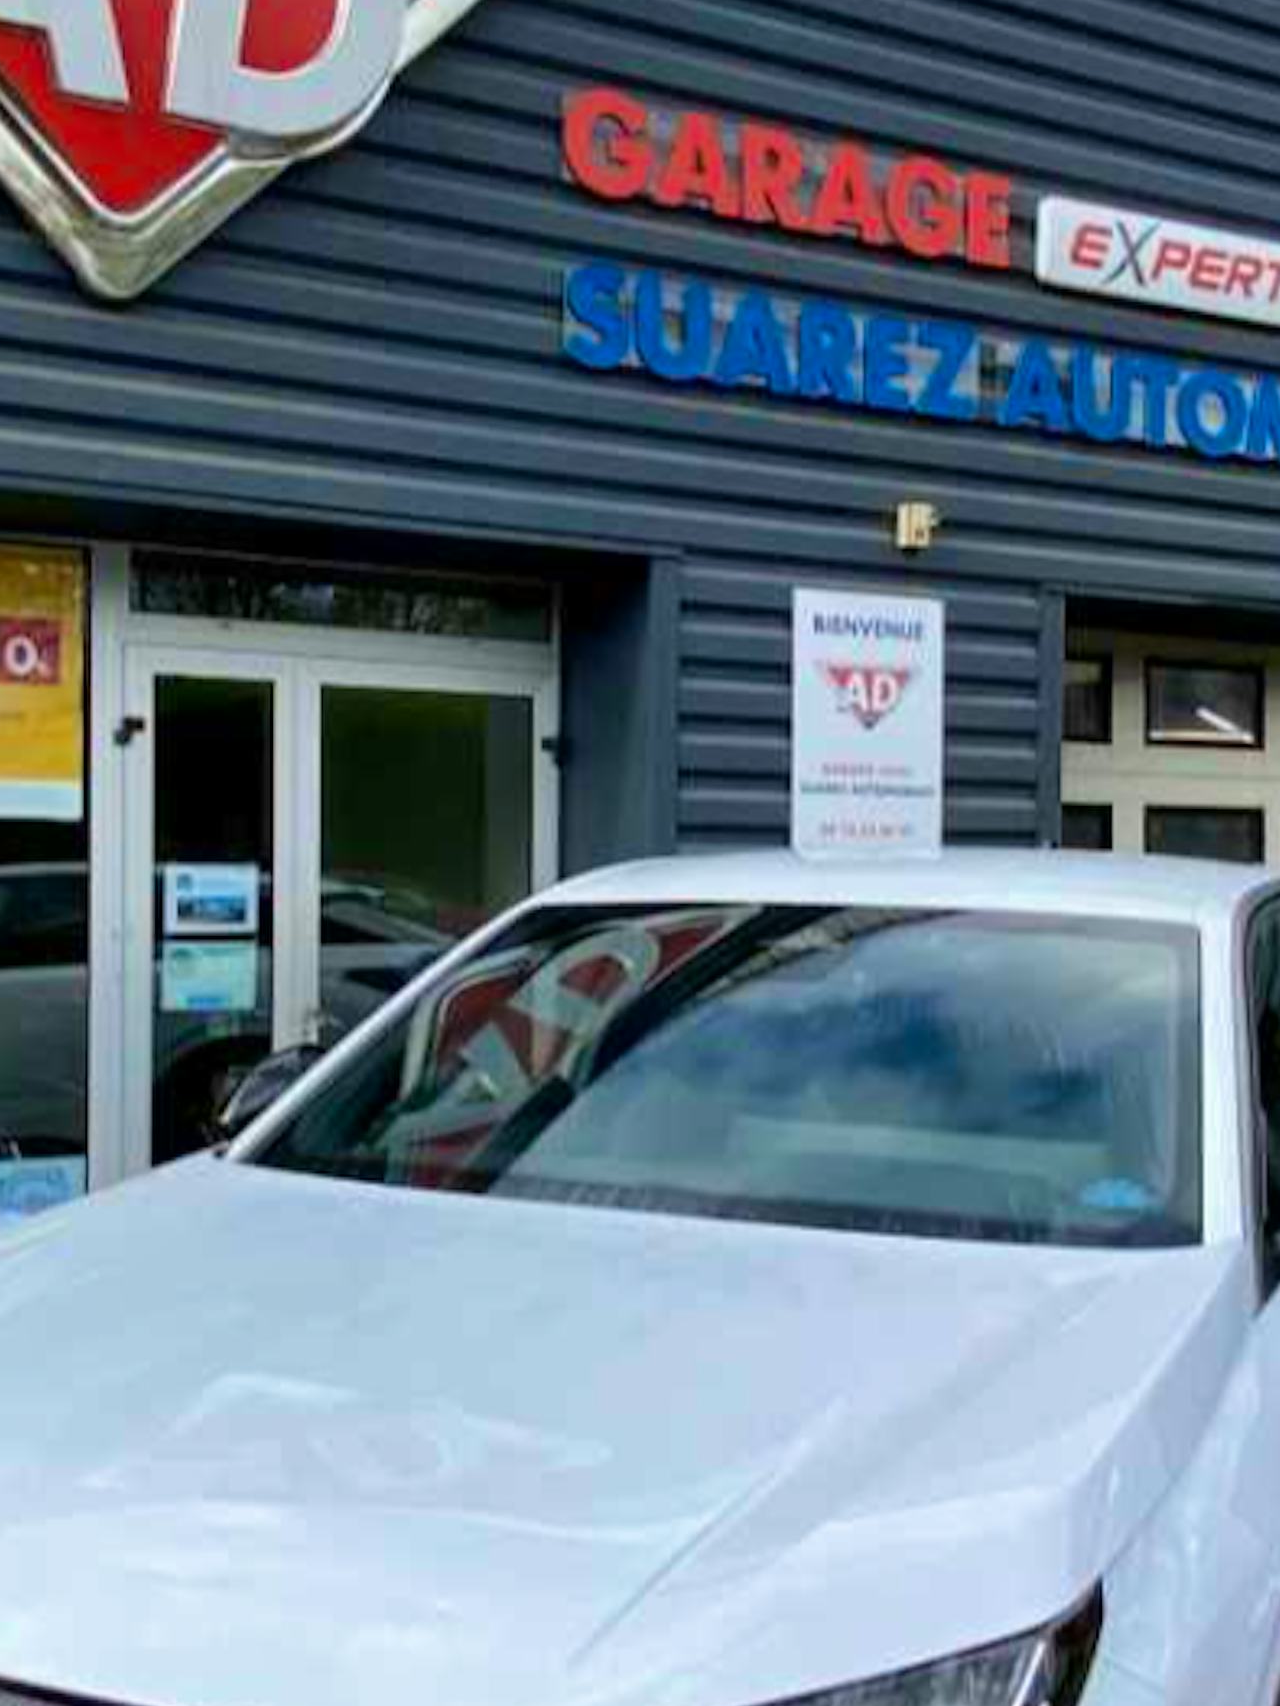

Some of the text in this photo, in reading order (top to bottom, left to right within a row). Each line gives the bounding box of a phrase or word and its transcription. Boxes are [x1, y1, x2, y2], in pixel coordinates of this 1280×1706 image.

[561, 86, 1012, 270] GARAGE
[563, 258, 984, 420] SUAREZ
[837, 672, 899, 713] AD
